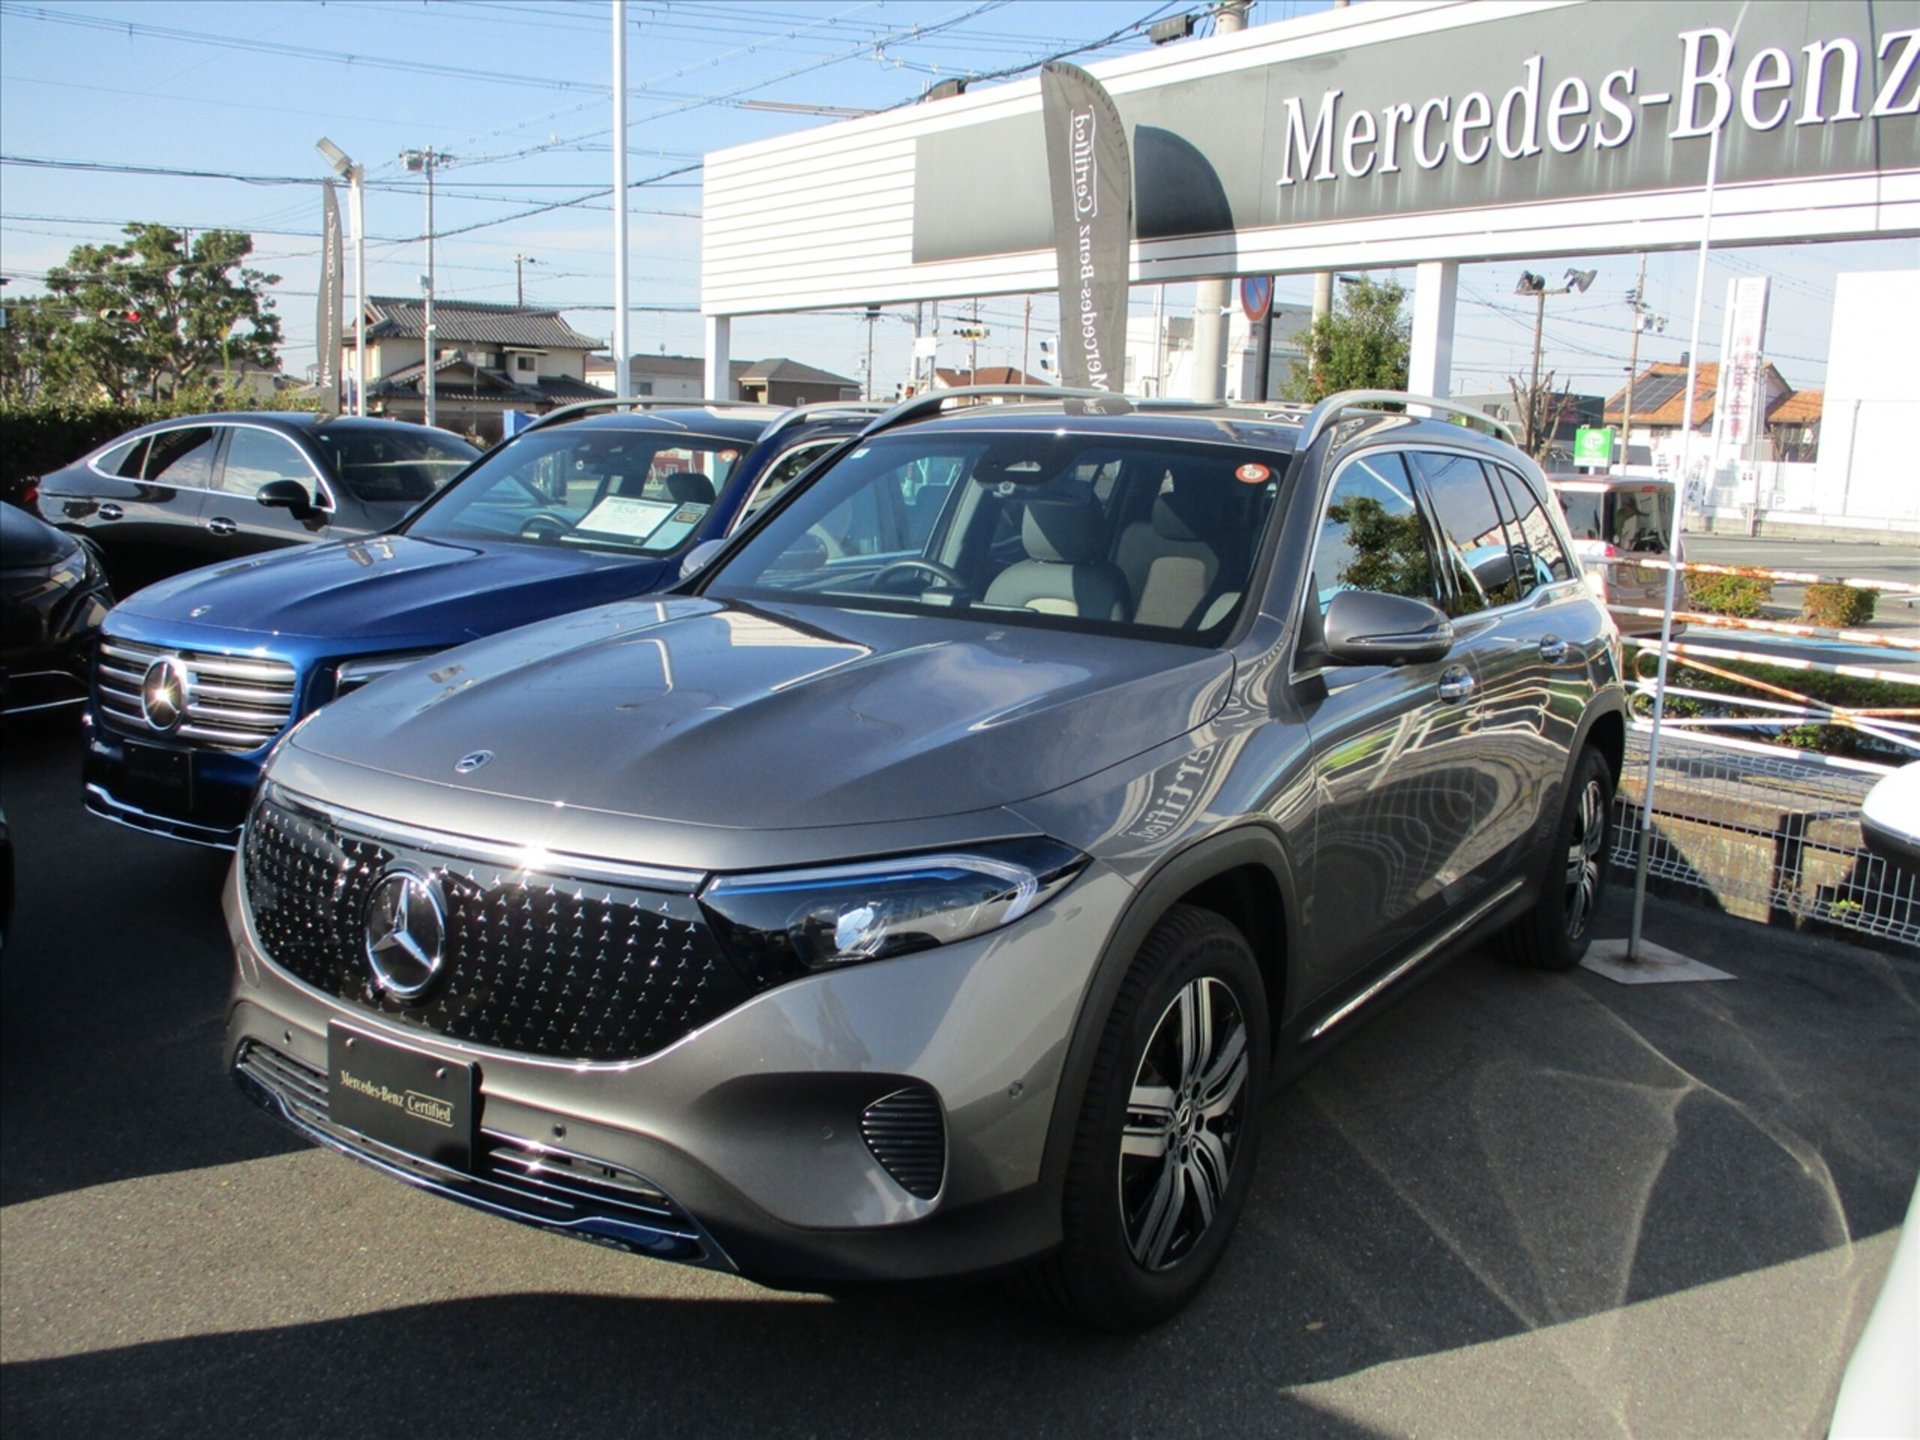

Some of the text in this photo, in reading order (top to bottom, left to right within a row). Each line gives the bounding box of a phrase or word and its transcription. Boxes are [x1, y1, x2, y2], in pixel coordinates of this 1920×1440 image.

[1277, 26, 1920, 186] Mercedes-Benz
[341, 1070, 451, 1121] Mercedes-Benz Certified
